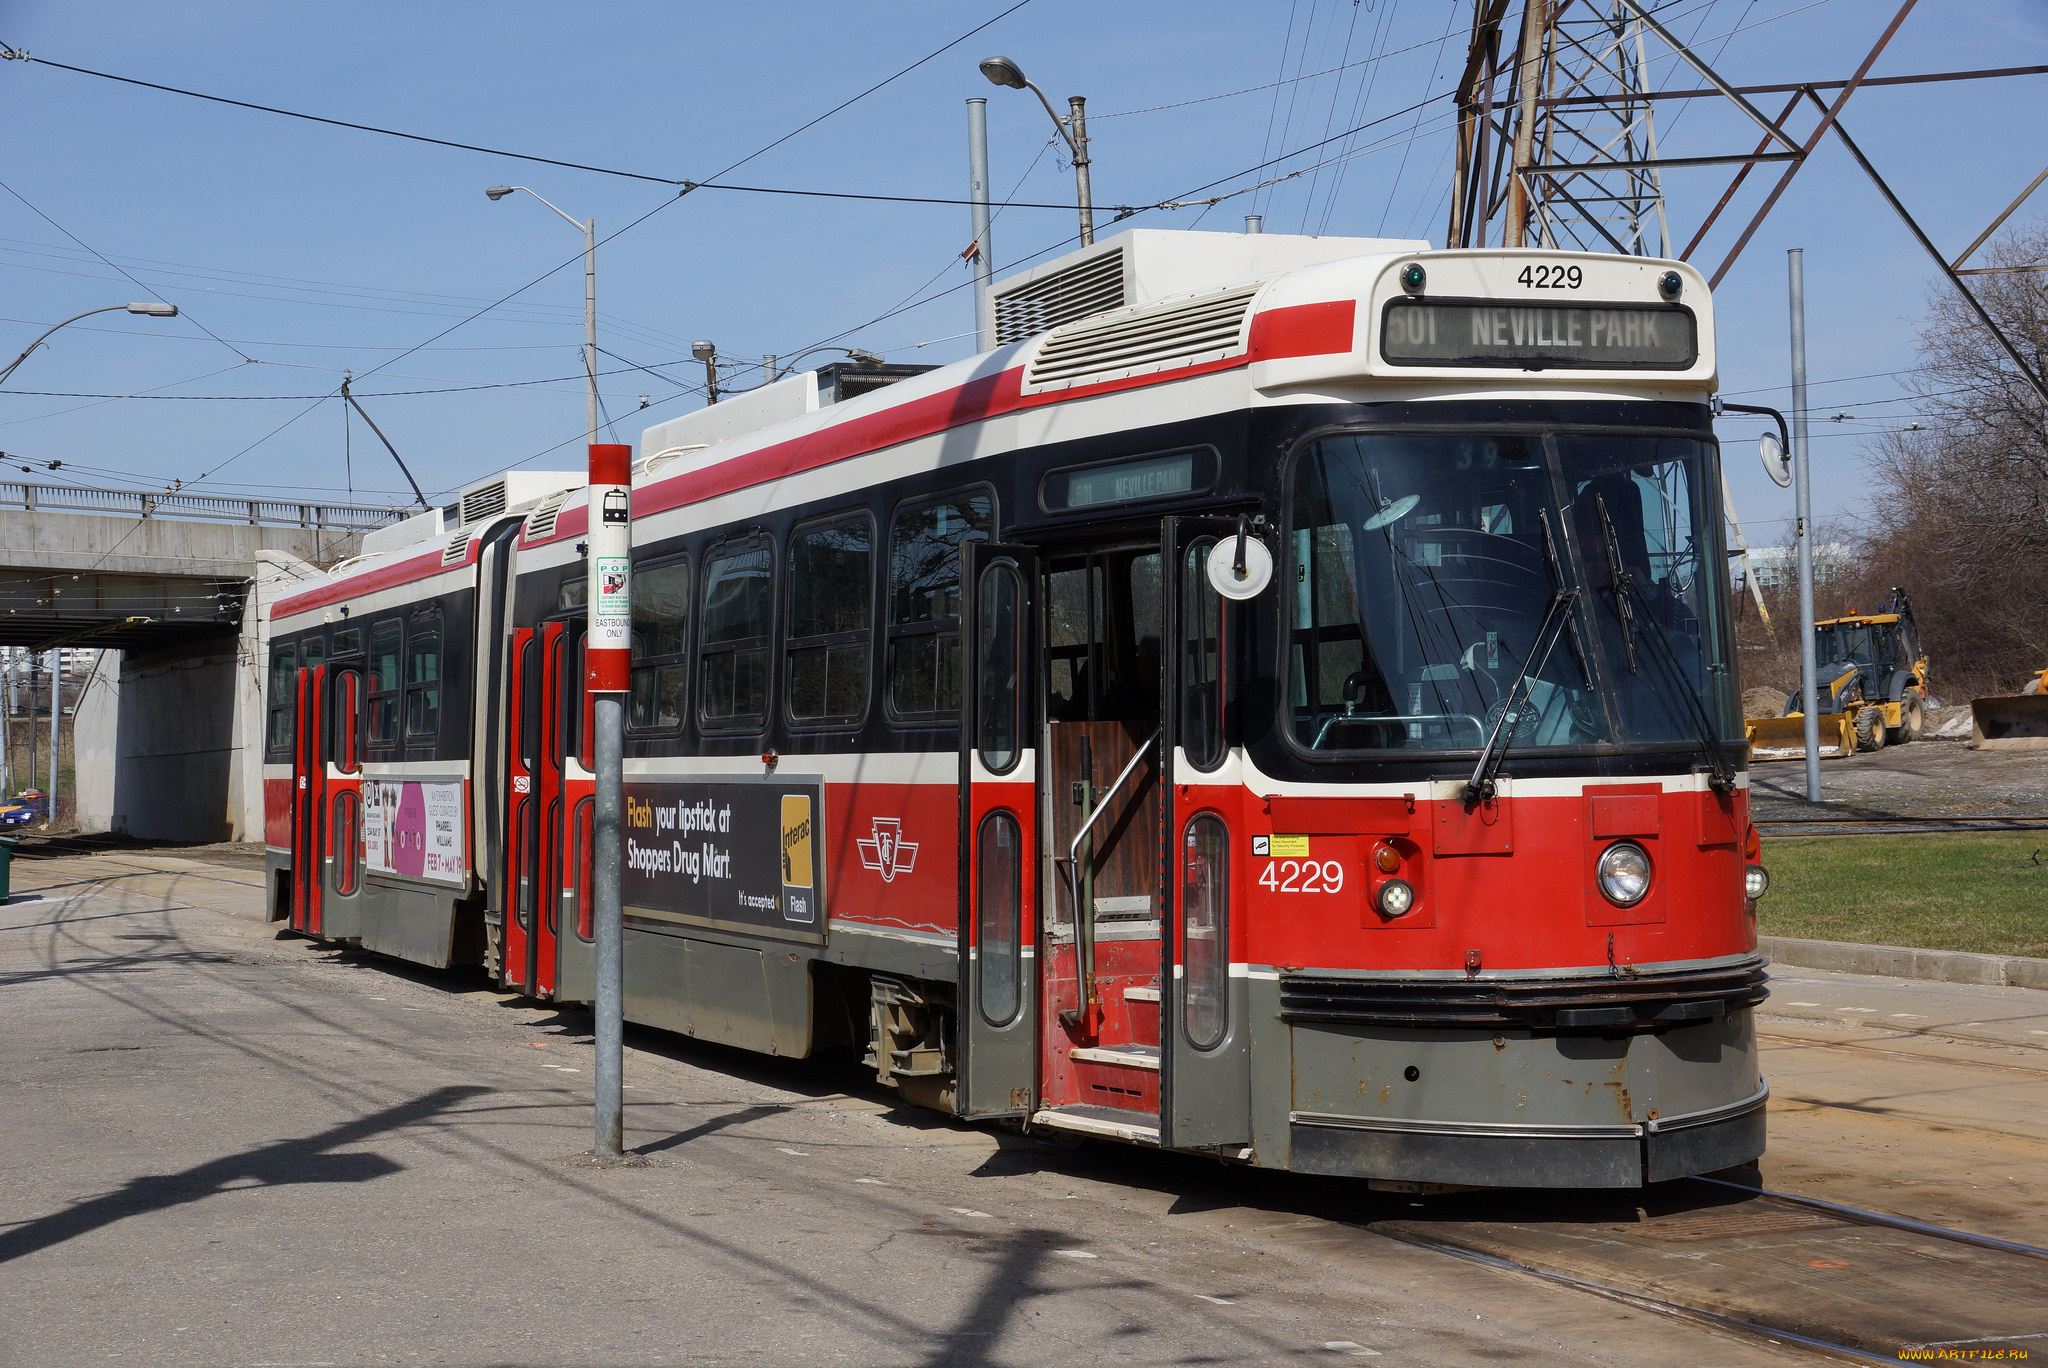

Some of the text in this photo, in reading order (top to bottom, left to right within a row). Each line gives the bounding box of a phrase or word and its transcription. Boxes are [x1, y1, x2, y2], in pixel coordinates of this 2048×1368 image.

[1517, 265, 1583, 289] 4229
[1387, 306, 1661, 348] 501 NEVILLE PARK
[1115, 472, 1154, 498] NEVILLE
[1156, 467, 1184, 492] PARK
[595, 618, 631, 628] EASTBOUND
[606, 629, 623, 638] ONLY
[627, 796, 731, 839] Flash your lipstick at
[783, 817, 810, 850] Interac
[427, 852, 437, 871] FEB
[445, 855, 456, 873] MAY
[627, 837, 732, 885] Shoppers Drug Mart.
[1258, 860, 1344, 894] 4229
[738, 889, 775, 912] It's accepted
[790, 895, 807, 913] Flash
